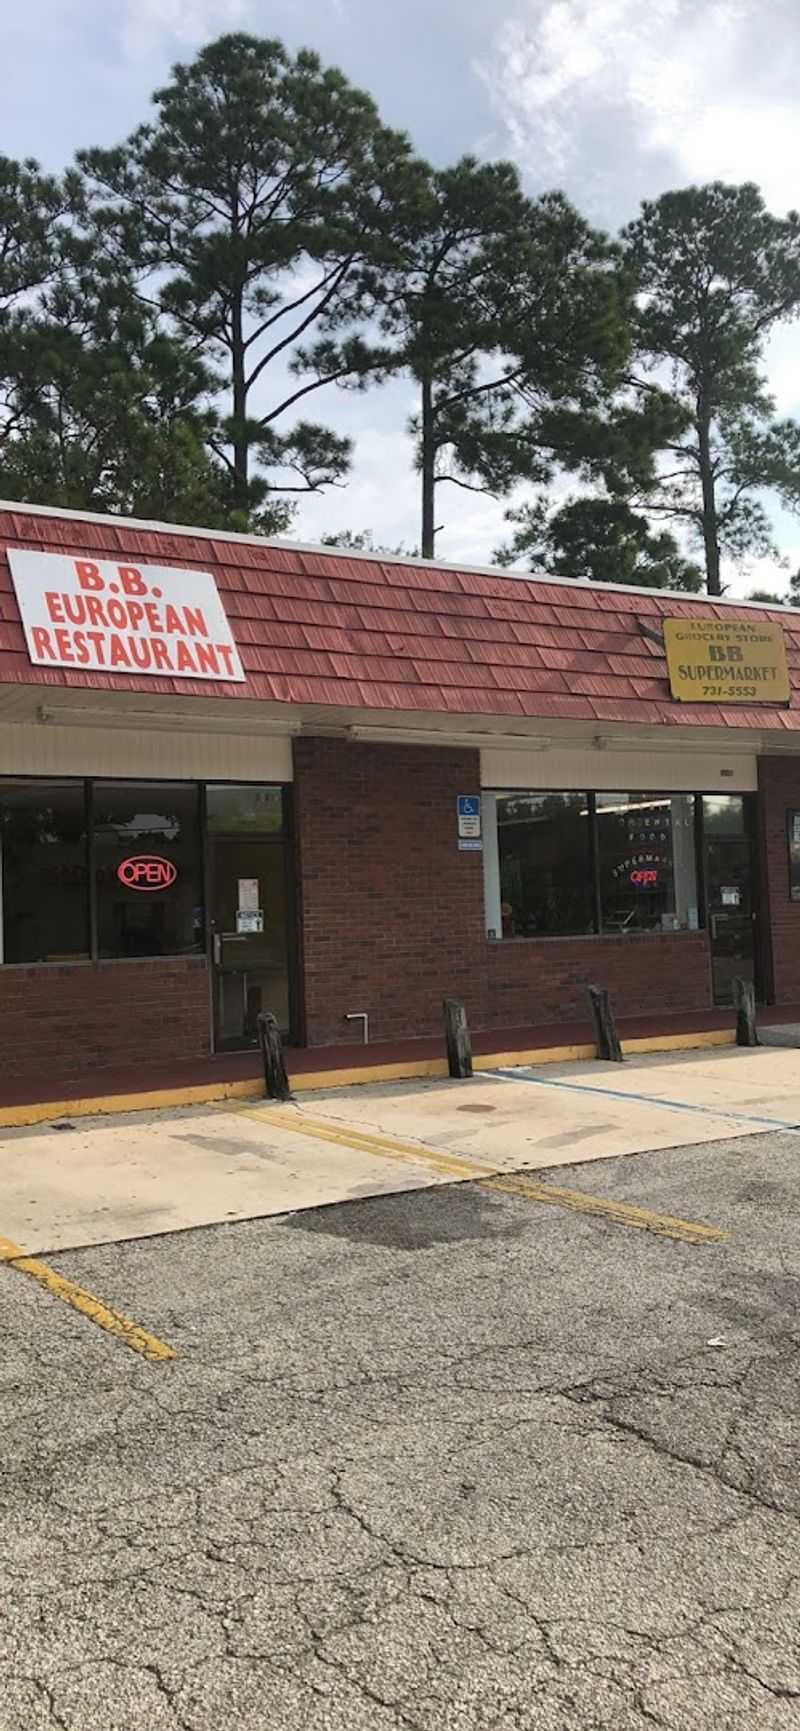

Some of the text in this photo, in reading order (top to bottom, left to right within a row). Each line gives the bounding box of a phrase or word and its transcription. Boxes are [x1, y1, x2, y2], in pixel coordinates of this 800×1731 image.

[74, 561, 163, 598] B.B.
[44, 591, 209, 638] EUROPEAN
[690, 622, 757, 633] EUROPEAN
[675, 632, 773, 642] GROCERY STORE
[31, 626, 235, 676] RESTAURANT
[709, 645, 744, 662] BB
[678, 665, 777, 681] SUPERMARKET
[121, 863, 171, 882] OPEN
[630, 870, 657, 883] OPEN
